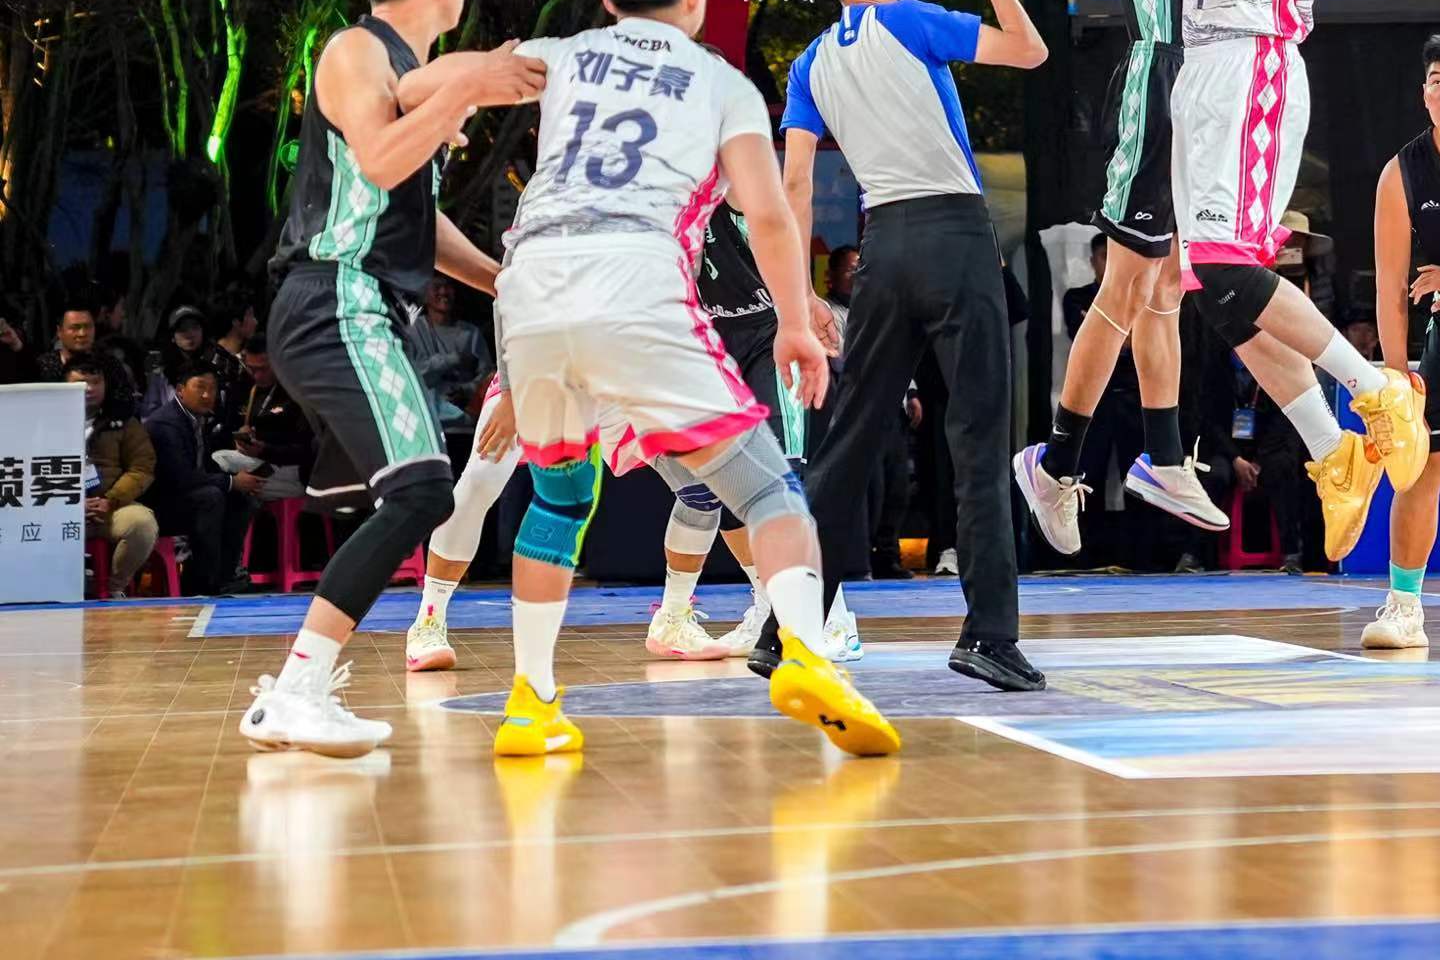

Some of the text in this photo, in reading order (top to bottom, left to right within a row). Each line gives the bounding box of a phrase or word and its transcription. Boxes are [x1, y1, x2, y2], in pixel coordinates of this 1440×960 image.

[571, 48, 695, 102] 刘子豪
[554, 100, 658, 189] 13
